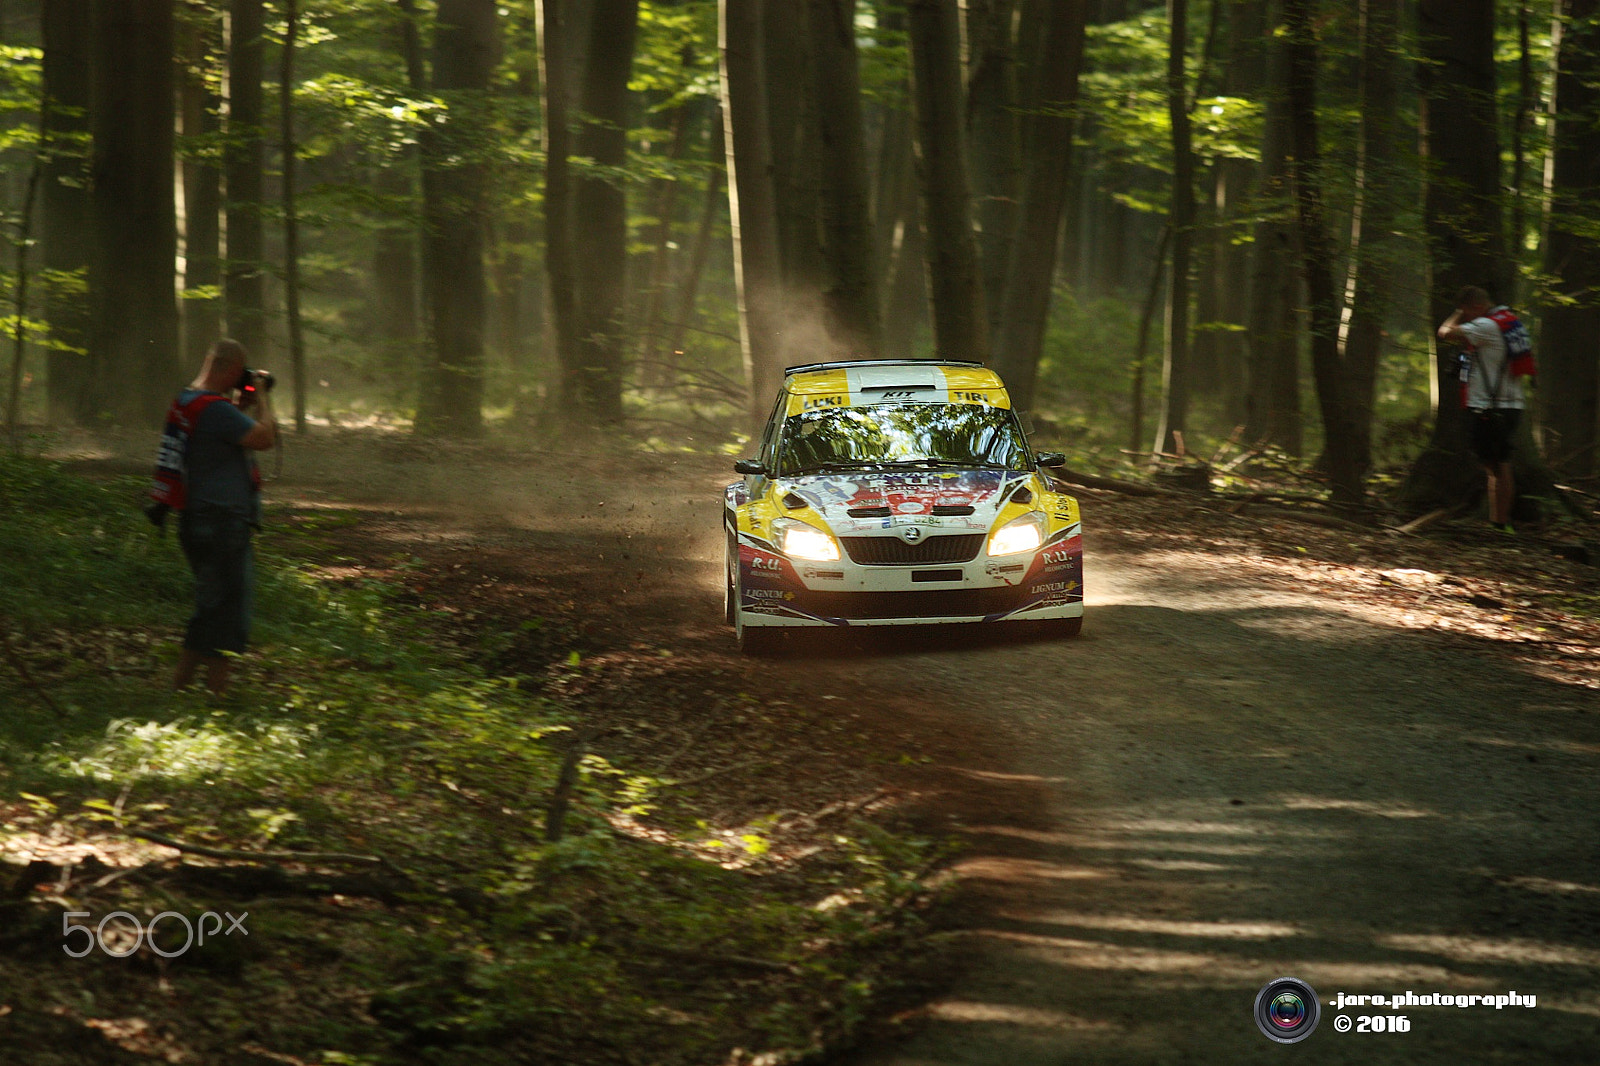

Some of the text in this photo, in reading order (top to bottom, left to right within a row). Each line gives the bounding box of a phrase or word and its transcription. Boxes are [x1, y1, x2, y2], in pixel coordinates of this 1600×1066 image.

[803, 396, 842, 410] LUKI
[953, 391, 988, 403] TIBI
[751, 556, 783, 571] R.U.
[1042, 550, 1073, 565] R.U.
[745, 588, 785, 599] LIGNUM
[1031, 581, 1065, 594] LIGNUM
